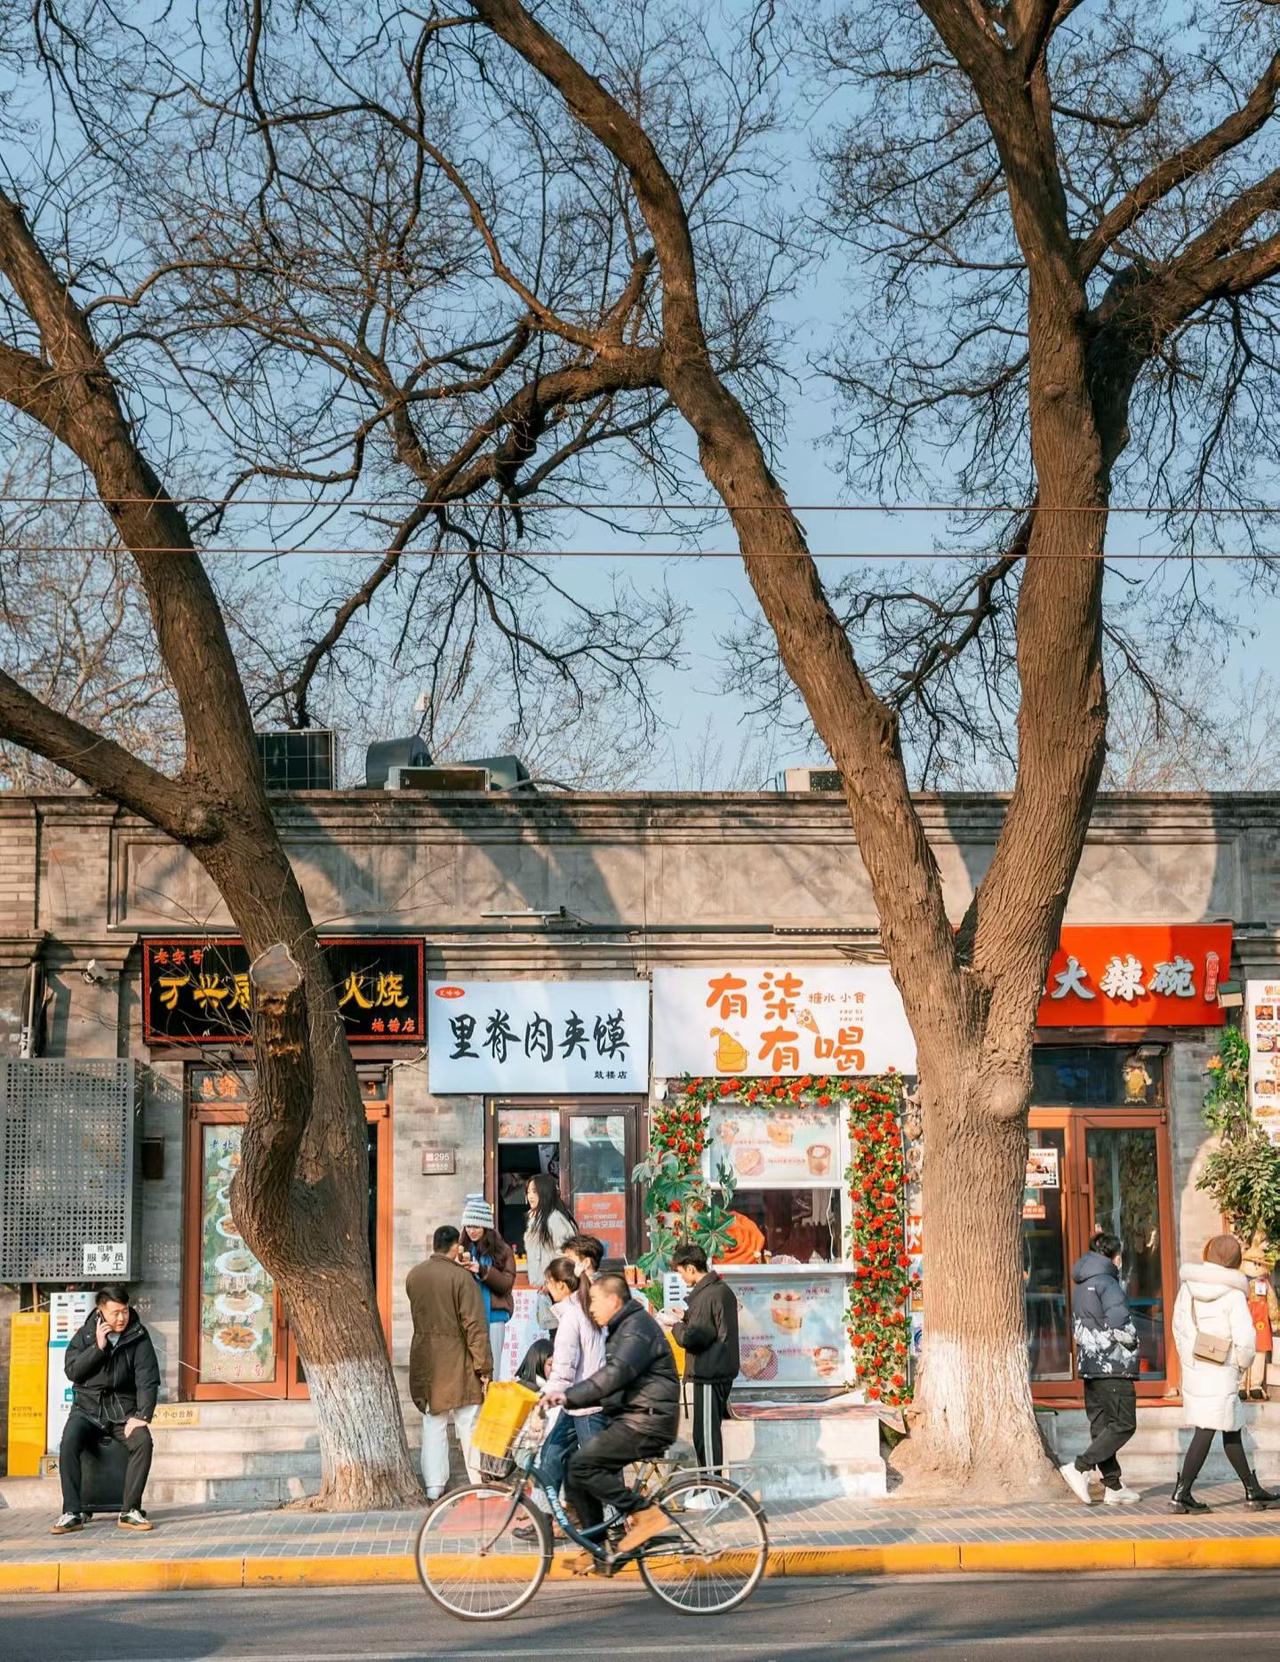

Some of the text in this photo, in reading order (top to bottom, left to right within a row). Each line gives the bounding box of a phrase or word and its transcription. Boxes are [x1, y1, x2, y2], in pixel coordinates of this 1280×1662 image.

[154, 948, 203, 964] 老字号
[338, 971, 409, 1009] 火烧
[706, 972, 804, 1020] 有柒
[1041, 954, 1196, 1001] 大辣碗
[840, 991, 866, 1004] 小食
[449, 1009, 630, 1064] 里脊肉夹馍
[758, 1026, 865, 1072] 有喝
[434, 1152, 450, 1161] 295
[87, 1252, 124, 1263] 服务员
